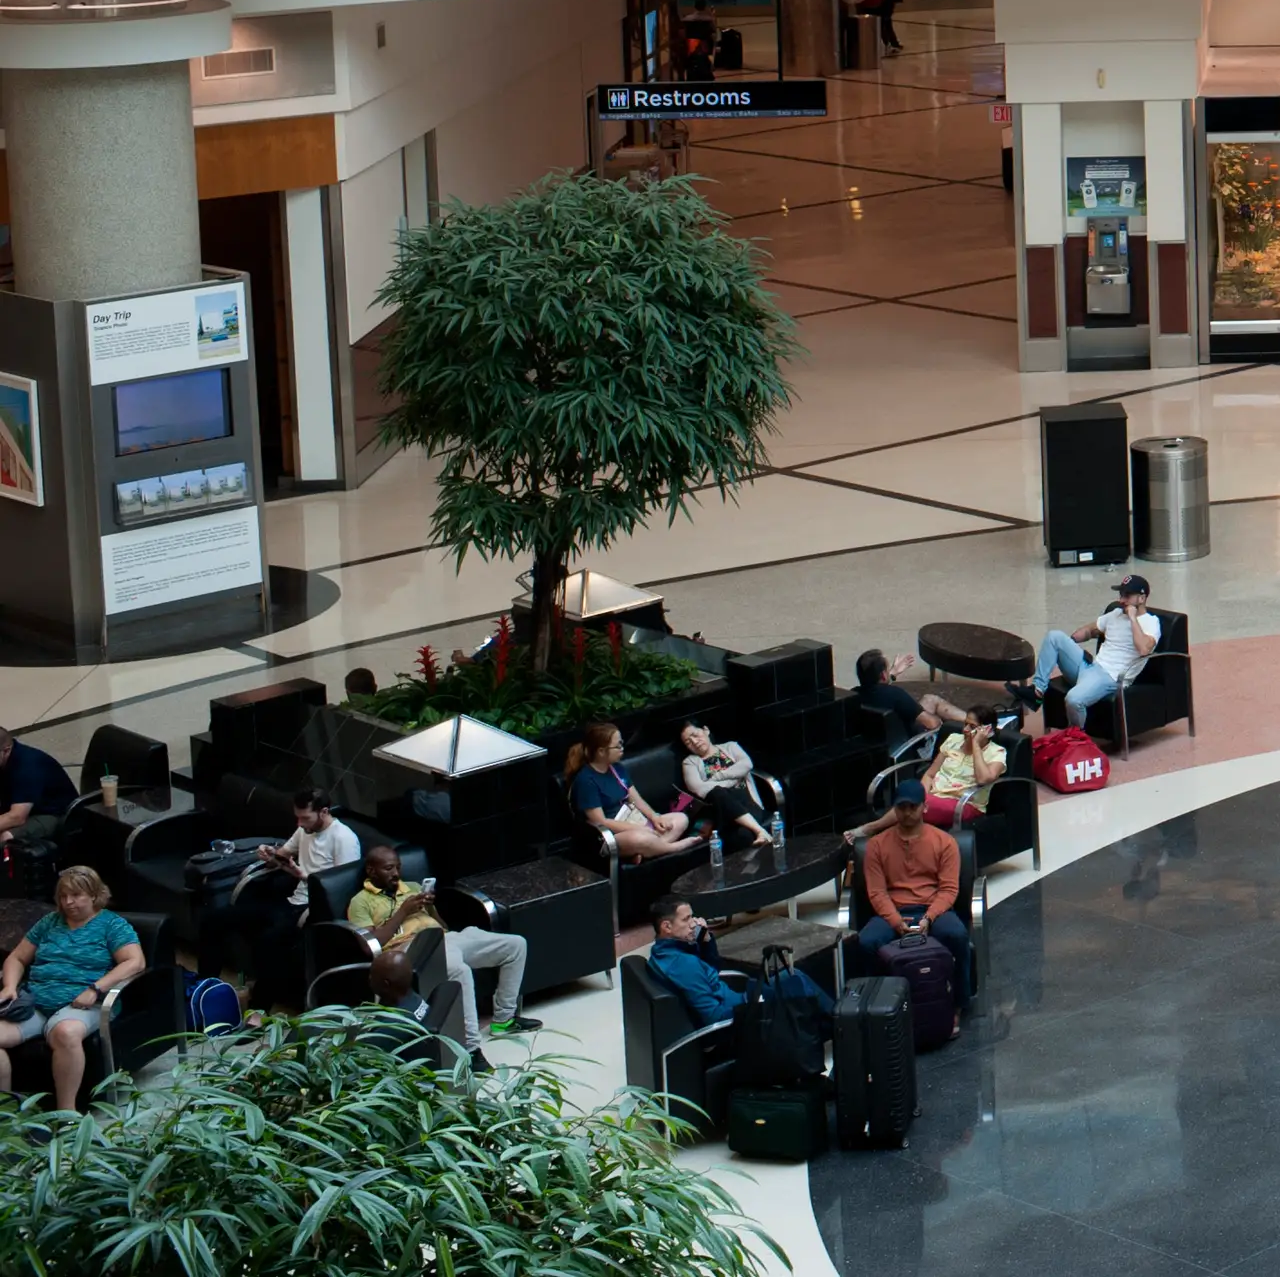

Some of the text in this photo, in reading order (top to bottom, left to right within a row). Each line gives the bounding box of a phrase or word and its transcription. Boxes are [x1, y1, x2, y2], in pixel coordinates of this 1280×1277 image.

[633, 89, 751, 107] Restrooms
[92, 310, 132, 324] Day Trip
[1065, 756, 1103, 785] HH
